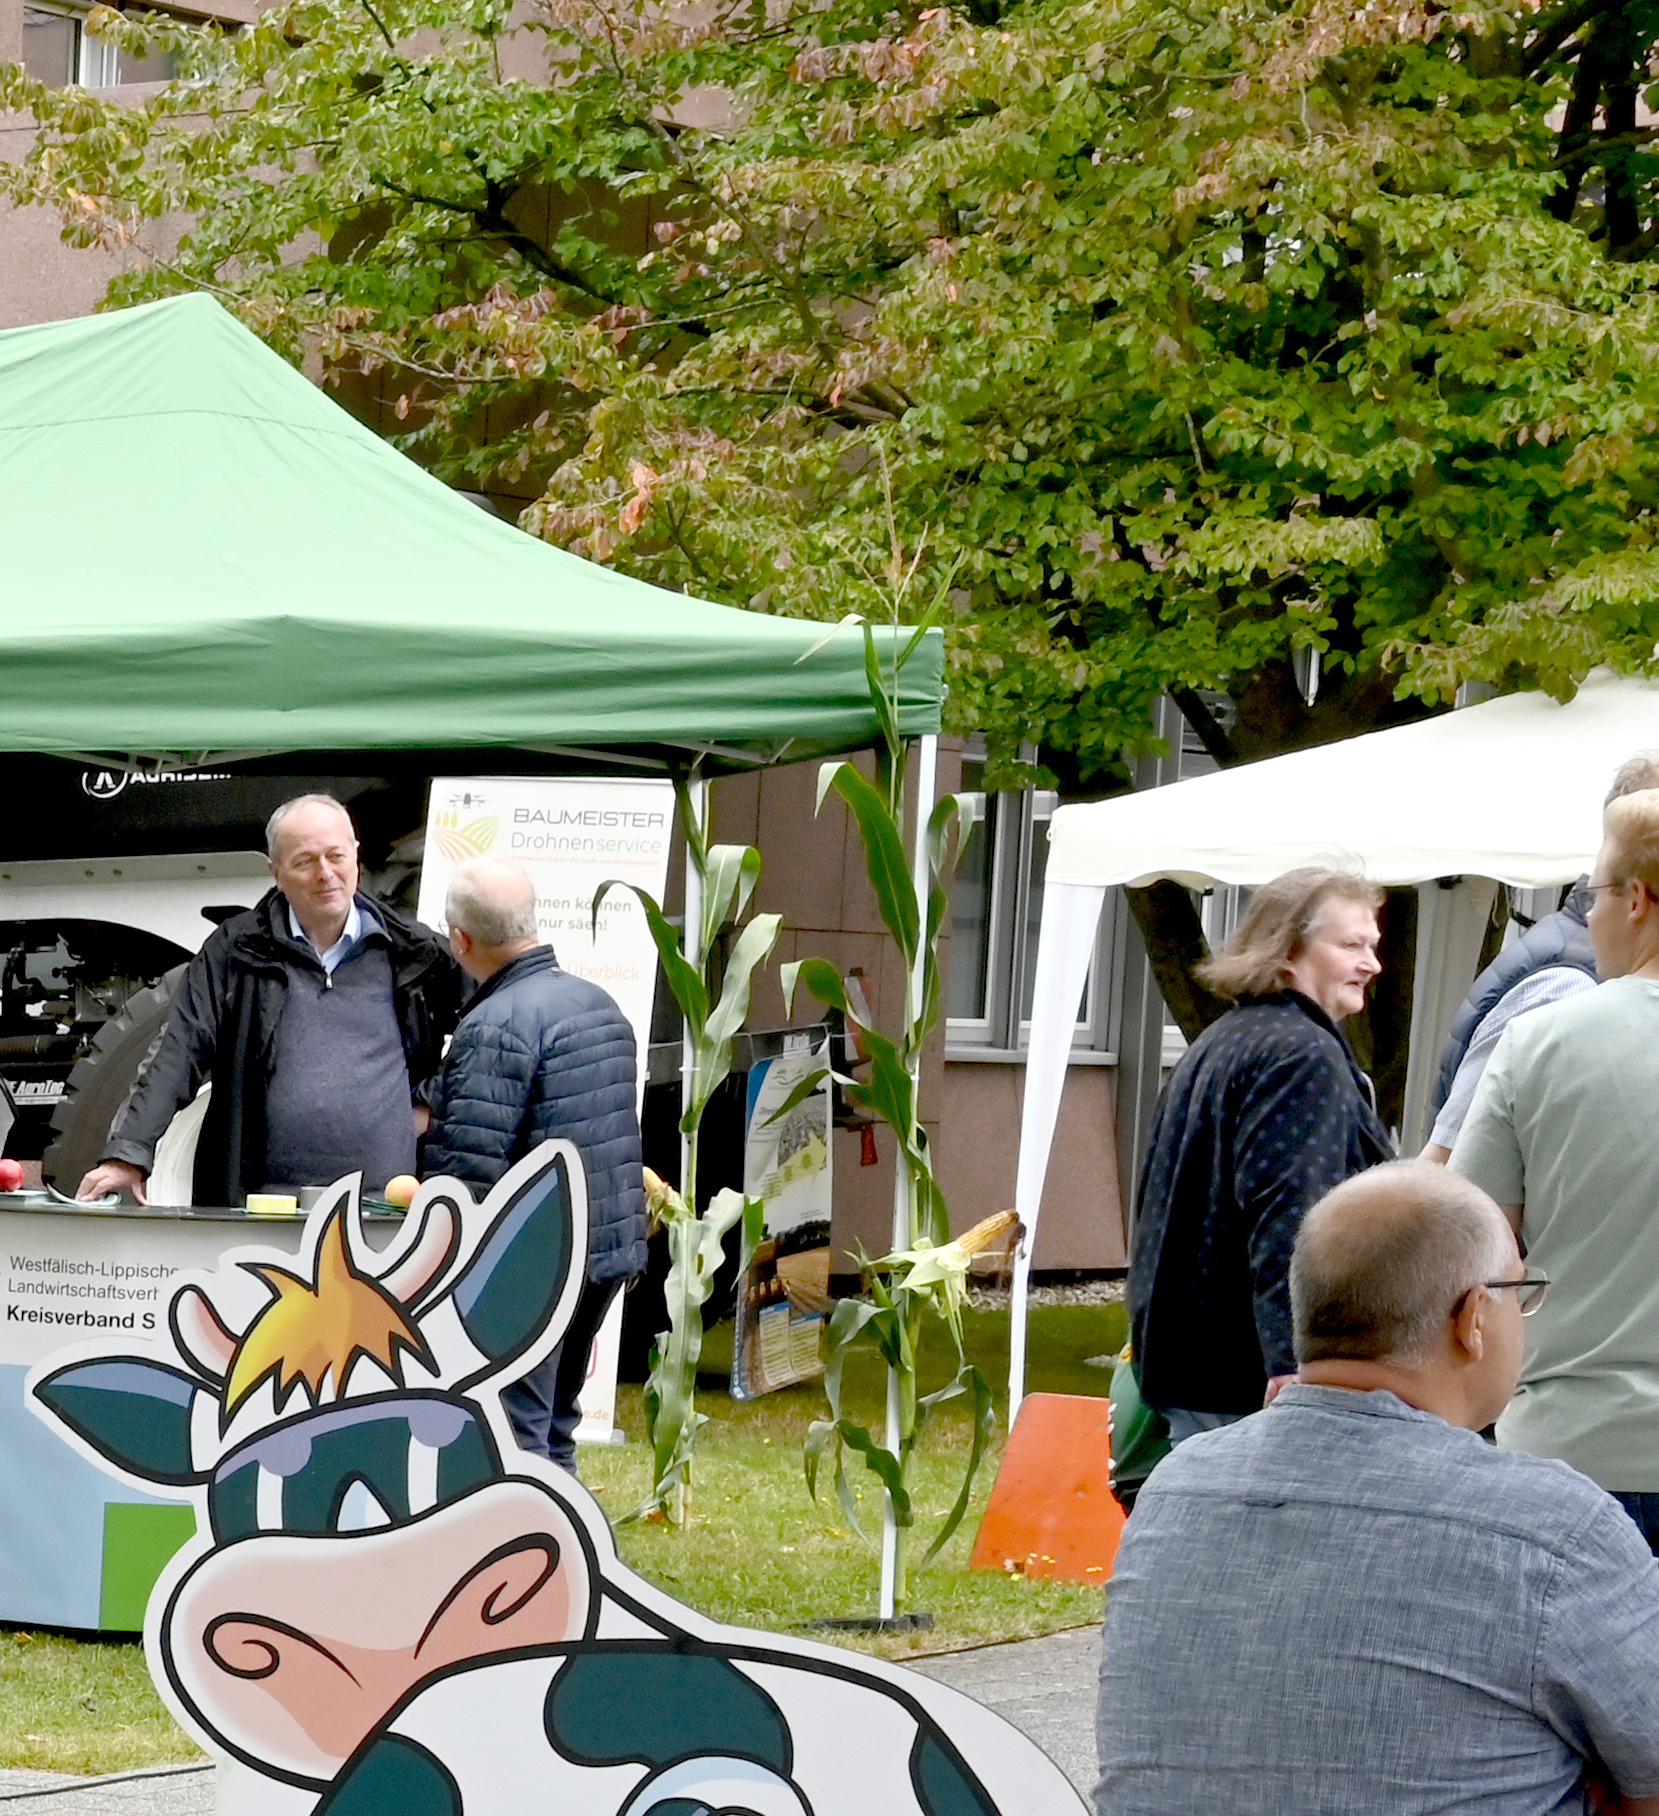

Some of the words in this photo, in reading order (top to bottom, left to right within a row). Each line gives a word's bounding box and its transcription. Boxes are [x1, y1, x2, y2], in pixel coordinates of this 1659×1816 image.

[513, 808, 665, 828] BAUMEISTER
[511, 832, 662, 854] Drohnenservice
[6, 1304, 135, 1329] Kreisverband
[141, 1312, 156, 1330] S
